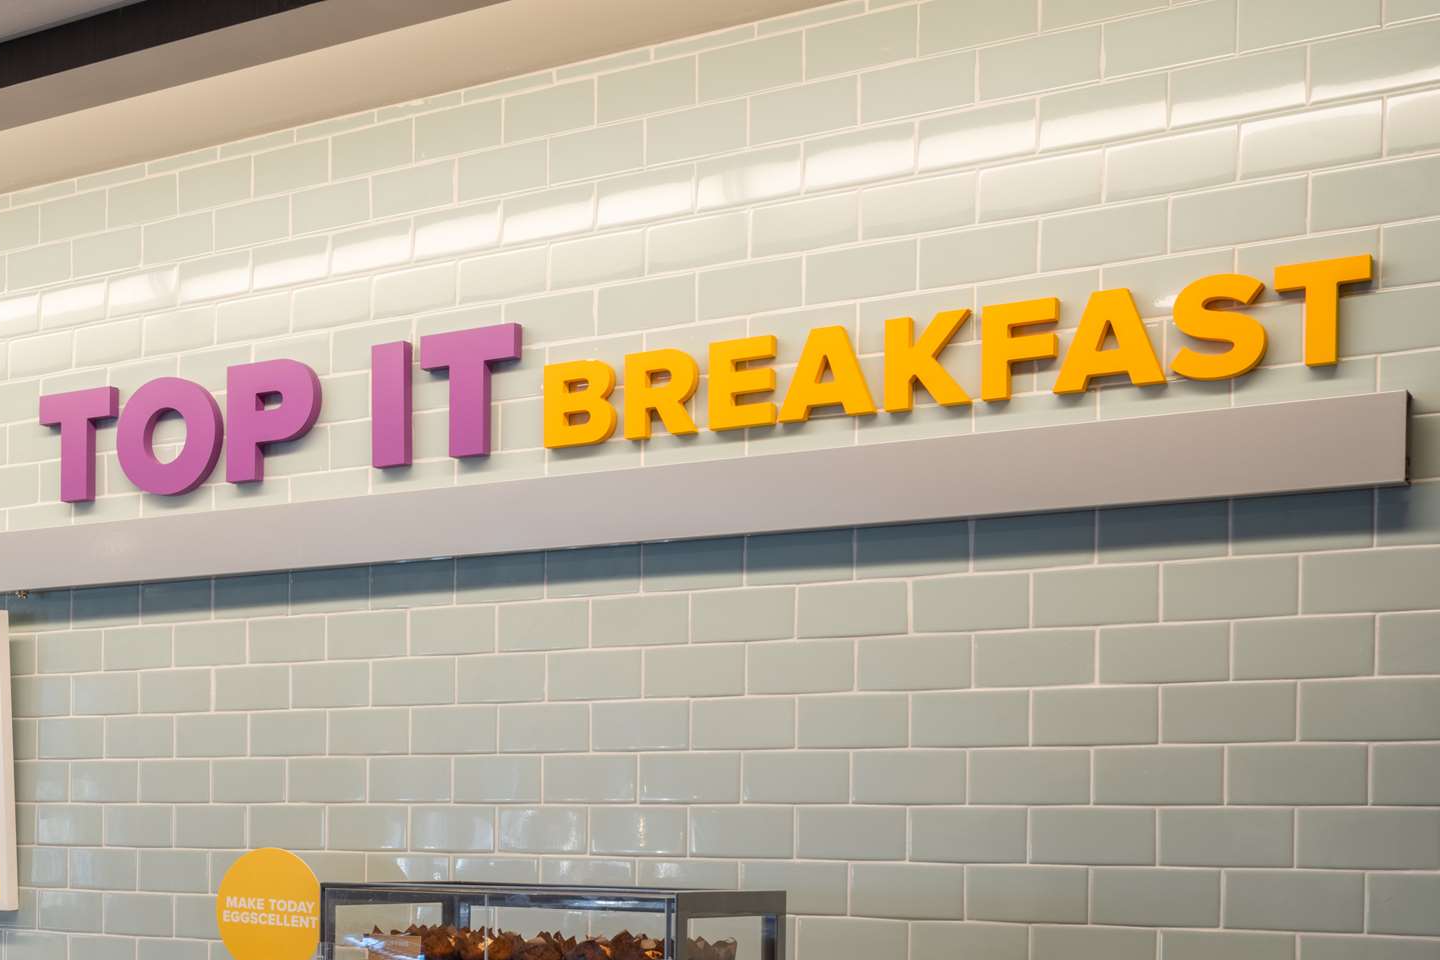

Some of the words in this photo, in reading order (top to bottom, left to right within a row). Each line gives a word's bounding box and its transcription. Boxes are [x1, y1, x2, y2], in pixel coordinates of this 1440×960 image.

[39, 358, 322, 503] TOP
[371, 322, 522, 469] IT
[544, 253, 1373, 449] BREAKFAST
[226, 896, 265, 910] MAKE
[269, 898, 315, 913] TODAY
[222, 910, 318, 929] EGGSCELLENT
